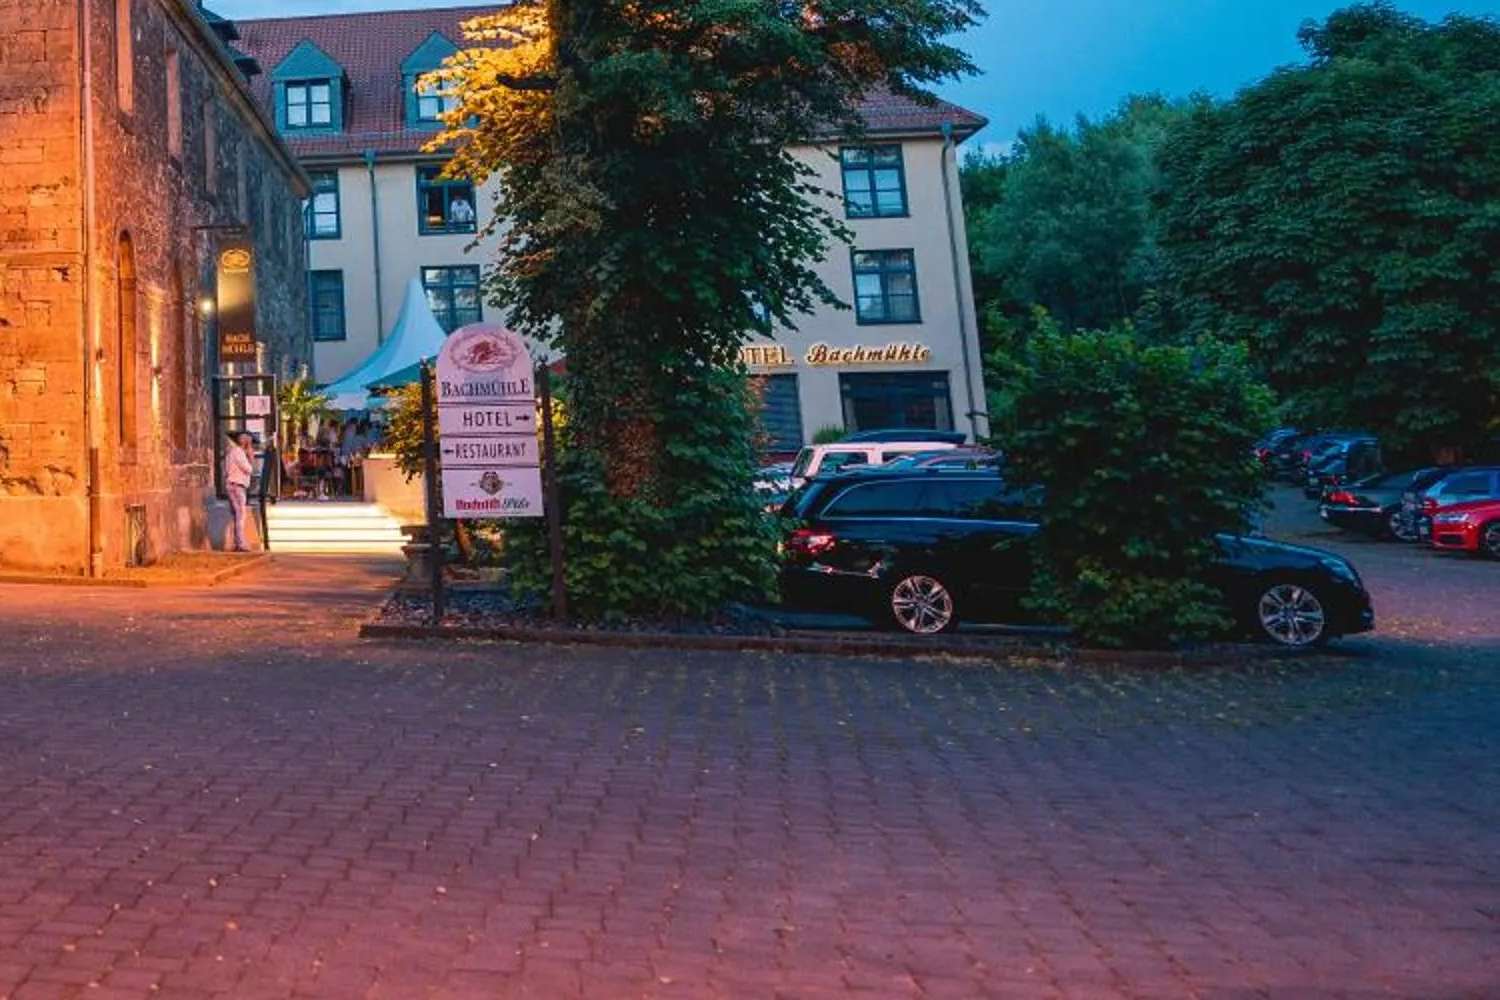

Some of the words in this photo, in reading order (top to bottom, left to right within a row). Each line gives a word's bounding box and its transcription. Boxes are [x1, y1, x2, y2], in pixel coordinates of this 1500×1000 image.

[735, 346, 795, 364] OTEL
[807, 343, 931, 365] Bachmühle
[441, 378, 530, 397] BACHMÜHLE
[463, 411, 512, 427] HOTEL
[455, 442, 526, 459] RESTAURANT
